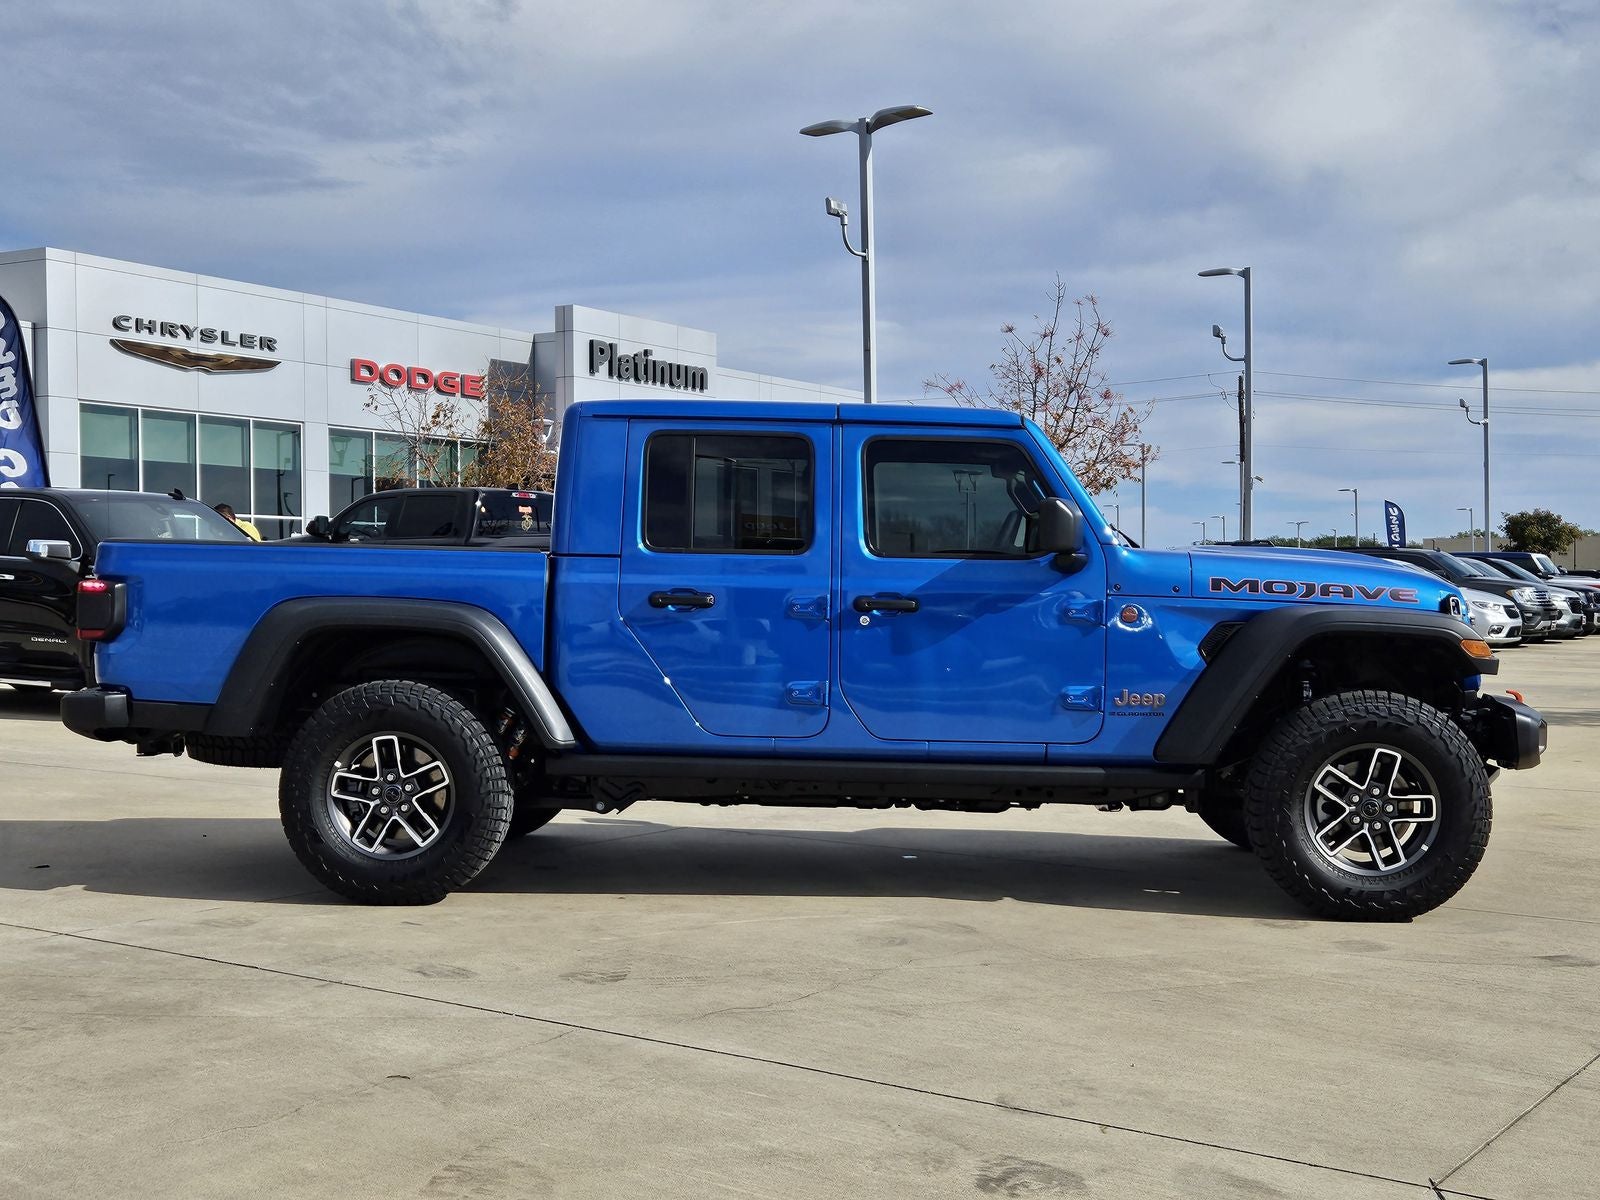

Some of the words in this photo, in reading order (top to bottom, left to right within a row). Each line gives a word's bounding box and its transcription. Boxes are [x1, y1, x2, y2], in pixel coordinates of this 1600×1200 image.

[112, 315, 278, 352] CHRYSLER
[350, 358, 486, 400] DODGE
[589, 339, 709, 393] Platinum
[1210, 576, 1420, 604] MOJAVE
[31, 636, 67, 644] DENALI
[1114, 688, 1167, 708] Jeep
